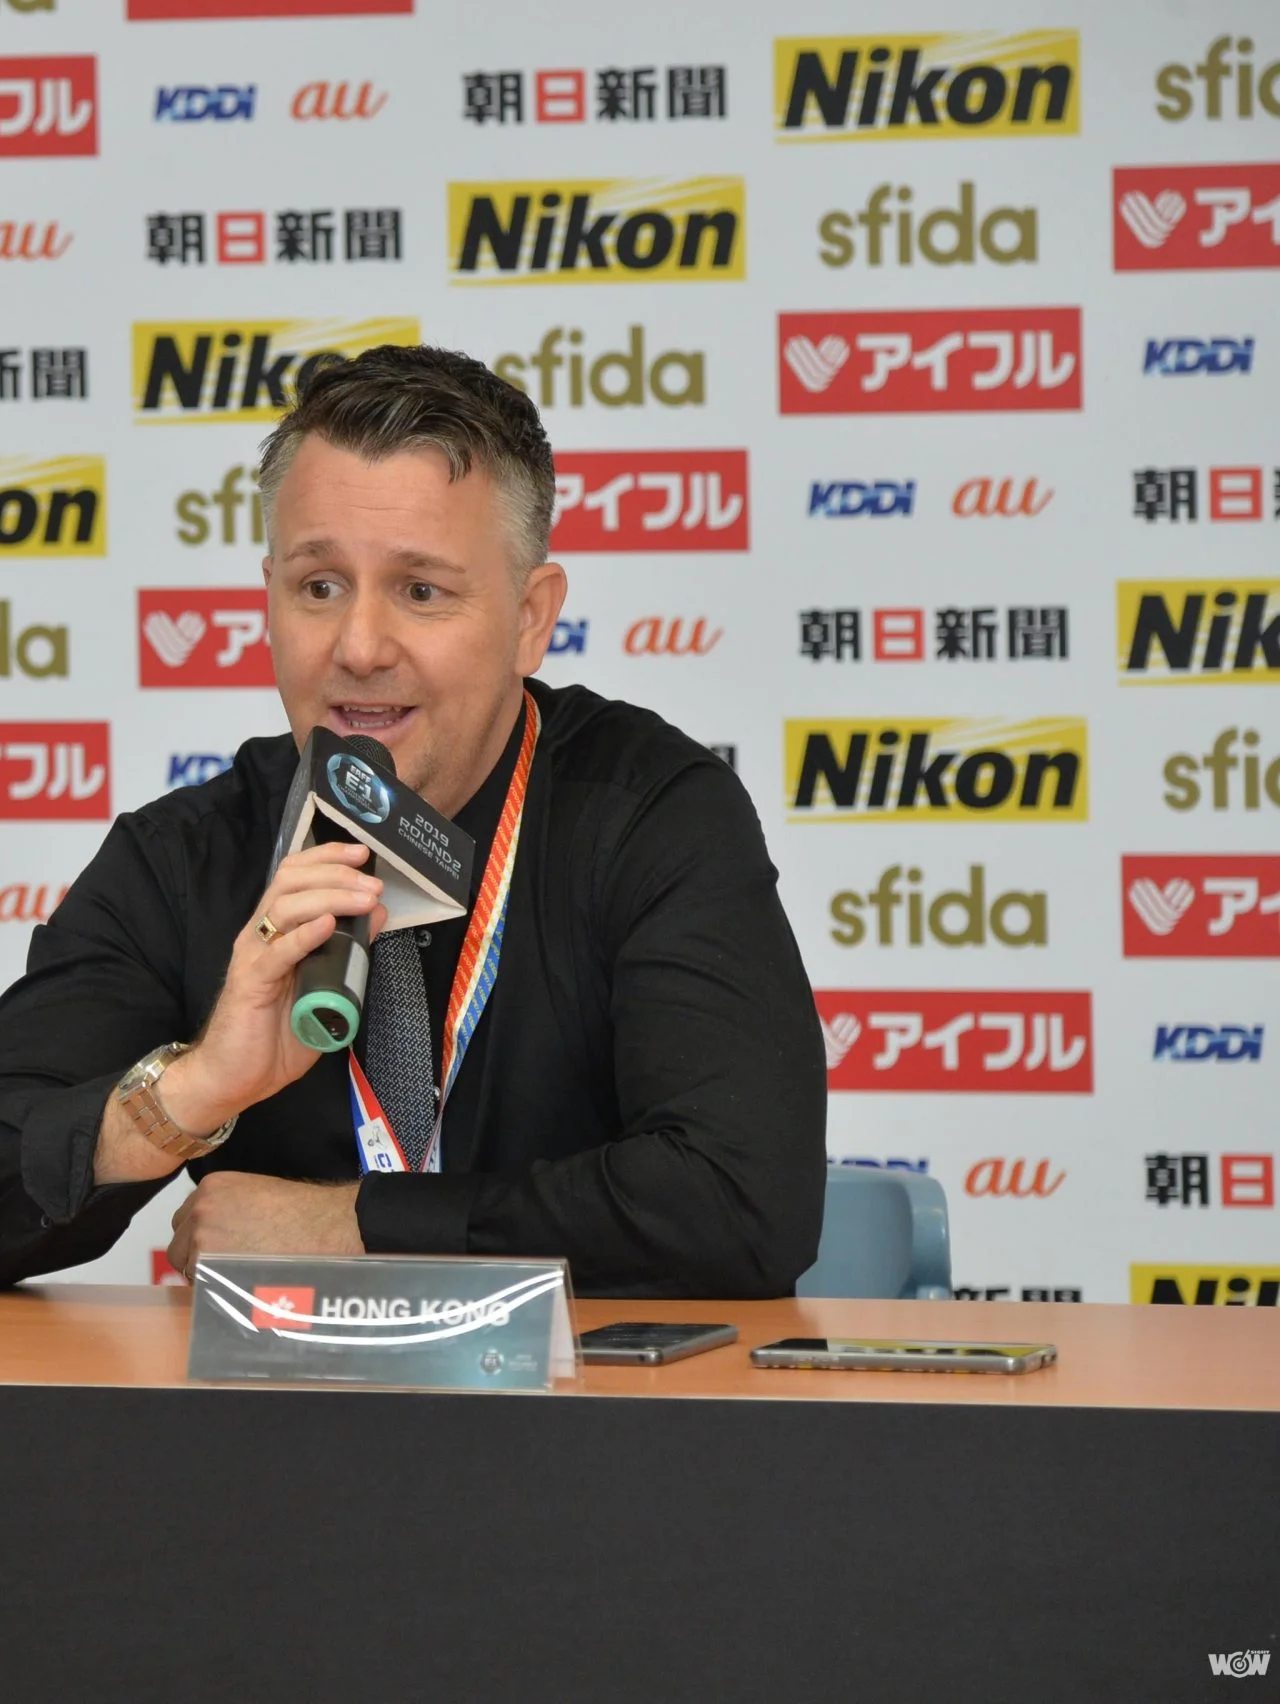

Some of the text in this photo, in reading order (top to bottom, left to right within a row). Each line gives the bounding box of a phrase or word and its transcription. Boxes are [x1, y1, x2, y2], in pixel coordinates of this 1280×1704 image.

[155, 81, 384, 123] KDDI au
[463, 66, 726, 125] 朝日新聞
[784, 47, 1071, 128] Nikon
[1155, 34, 1280, 122] sfi
[147, 209, 401, 265] 朝日新聞
[459, 193, 737, 271] Nikon
[820, 183, 1037, 267] sfida
[857, 331, 1075, 391] アイフル
[1143, 338, 1255, 375] KDDI
[176, 463, 267, 547] sfi
[809, 477, 1050, 518] KDDI au
[1132, 466, 1280, 522] 朝日
[623, 616, 720, 656] au
[800, 607, 1069, 662] 朝日新聞
[1126, 592, 1280, 669] Nik
[794, 730, 1079, 809] Nikon
[1163, 726, 1280, 812] sfi
[398, 827, 460, 880] CHINESE TAIPEI
[415, 813, 449, 848] 2019
[830, 866, 1046, 946] sfida
[867, 1012, 1087, 1071] アイフル
[1153, 1024, 1265, 1062] KDDI
[963, 1157, 1065, 1198] au
[1144, 1150, 1275, 1208] 朝日
[320, 1297, 411, 1322] HONG
